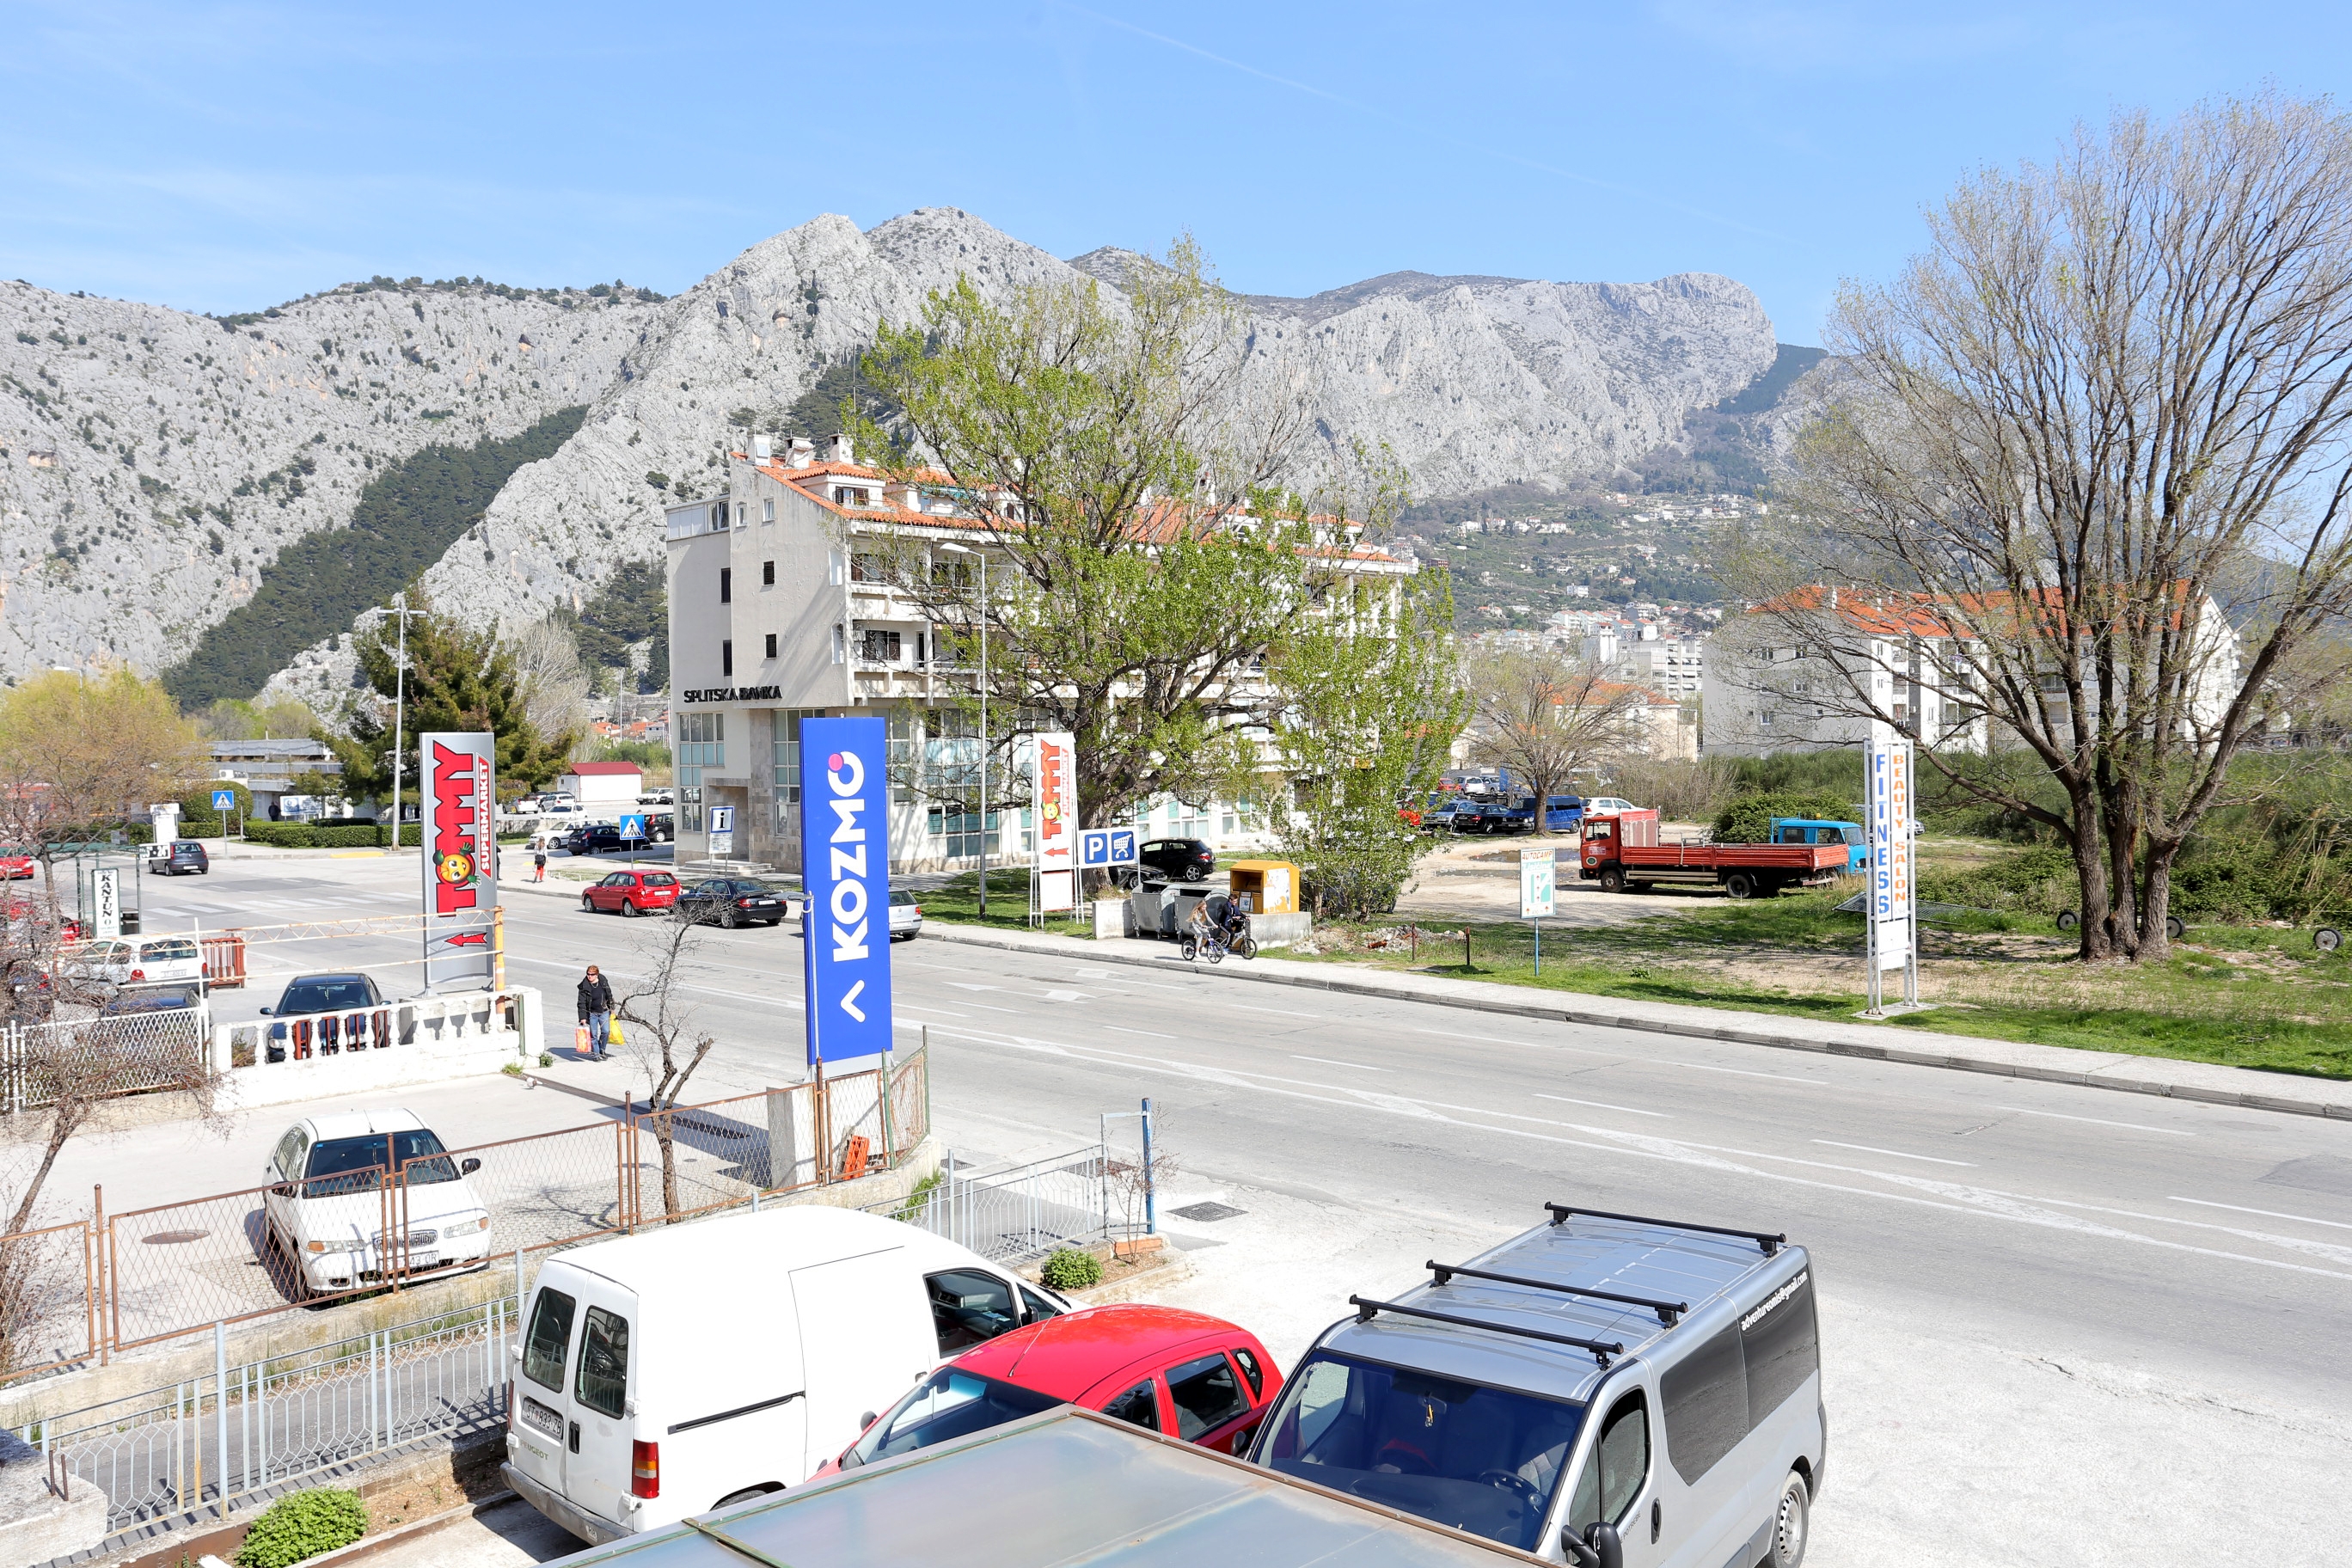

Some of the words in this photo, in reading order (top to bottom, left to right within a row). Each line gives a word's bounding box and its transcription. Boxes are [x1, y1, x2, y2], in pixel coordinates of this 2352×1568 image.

[683, 689, 738, 703] SPLITSKA
[739, 685, 782, 700] BANKA
[479, 763, 489, 870] SUPERMARKET
[1041, 738, 1062, 840] TOMMY
[1893, 754, 1905, 829] BEAUTY
[432, 739, 476, 917] TOMMY
[827, 750, 869, 963] KOZMO
[1089, 837, 1104, 861] P
[1522, 850, 1553, 860] AUTOCAMP
[1877, 754, 1889, 914] FITNESS
[101, 874, 113, 917] KANTUN
[1895, 842, 1906, 902] SALON
[1741, 1271, 1808, 1332] adventureomis@gmail.com
[526, 1404, 536, 1420] ST
[520, 1439, 548, 1461] PEUGEOT
